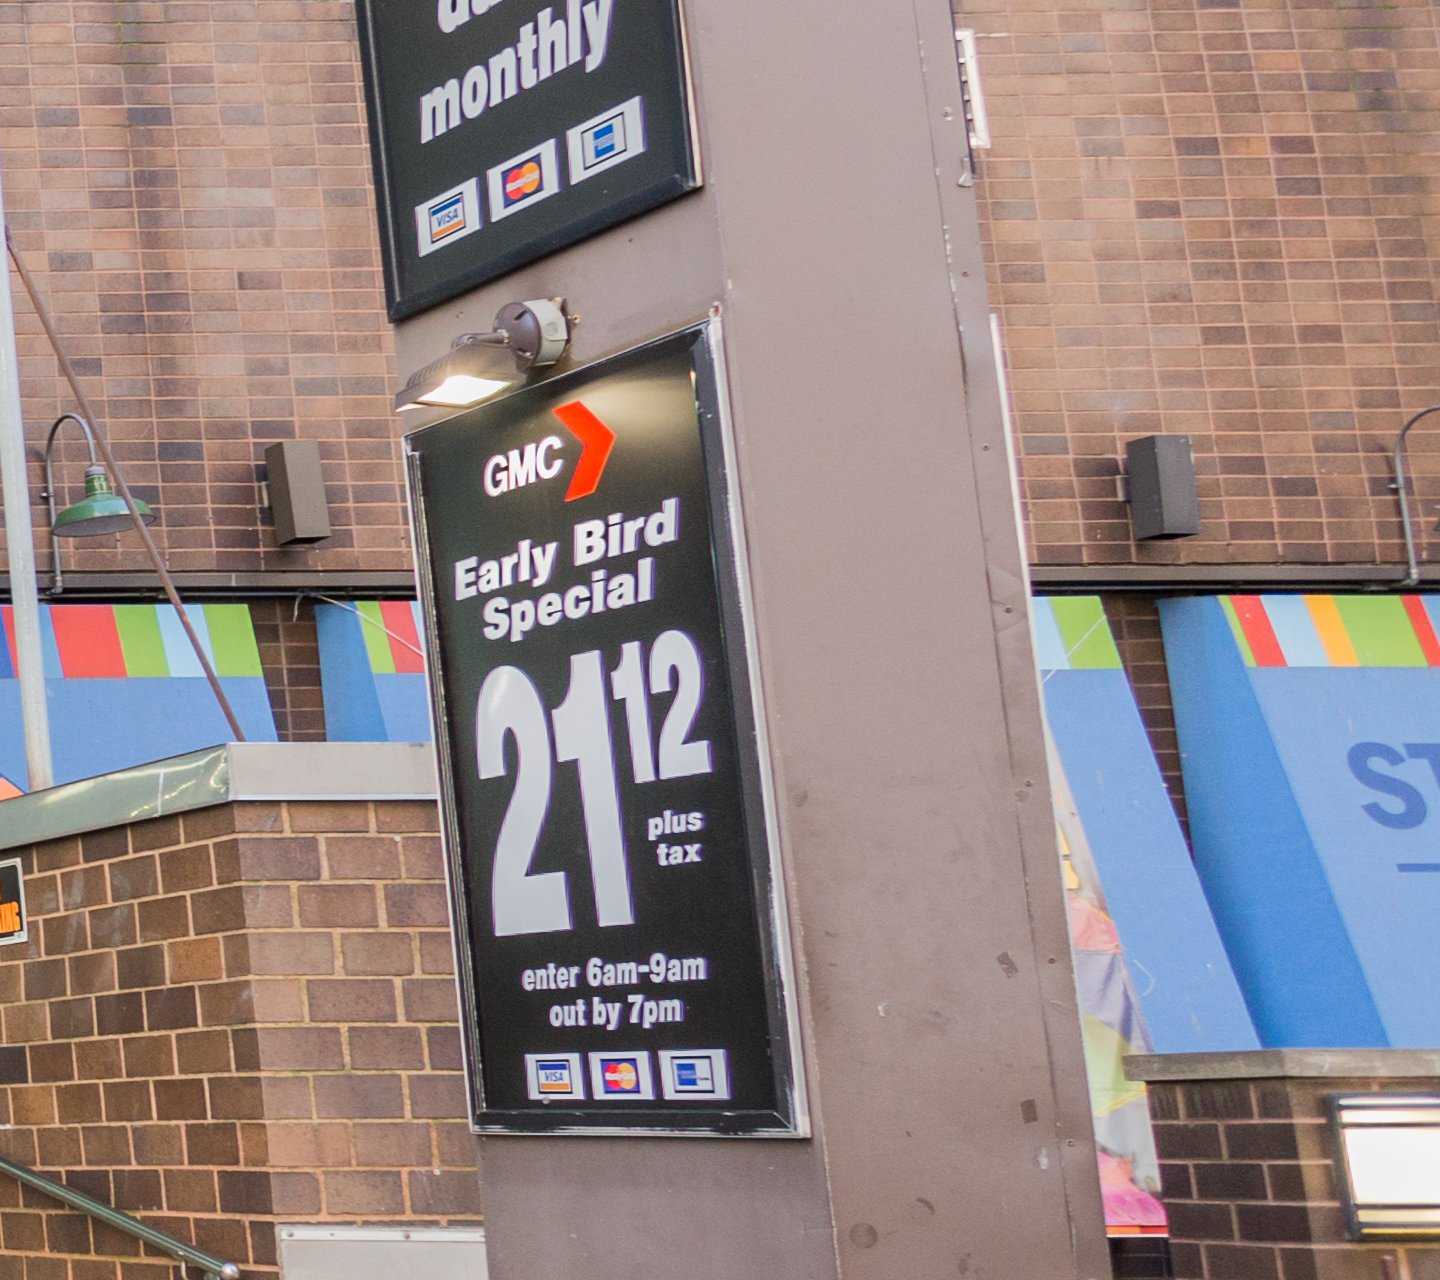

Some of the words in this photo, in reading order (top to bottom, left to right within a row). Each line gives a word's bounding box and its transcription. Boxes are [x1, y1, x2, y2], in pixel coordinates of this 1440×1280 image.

[435, 208, 459, 227] VISA
[483, 435, 564, 499] GMC
[453, 539, 559, 602] Early
[573, 497, 680, 566] Bird
[482, 556, 655, 643] Special
[647, 809, 703, 842] plus
[656, 840, 702, 867] tax
[522, 962, 581, 991] enter
[586, 953, 708, 987] 6am-9am
[549, 998, 588, 1027] out
[592, 996, 622, 1030] by
[627, 994, 684, 1029] 7pm
[544, 1071, 564, 1082] VISA
